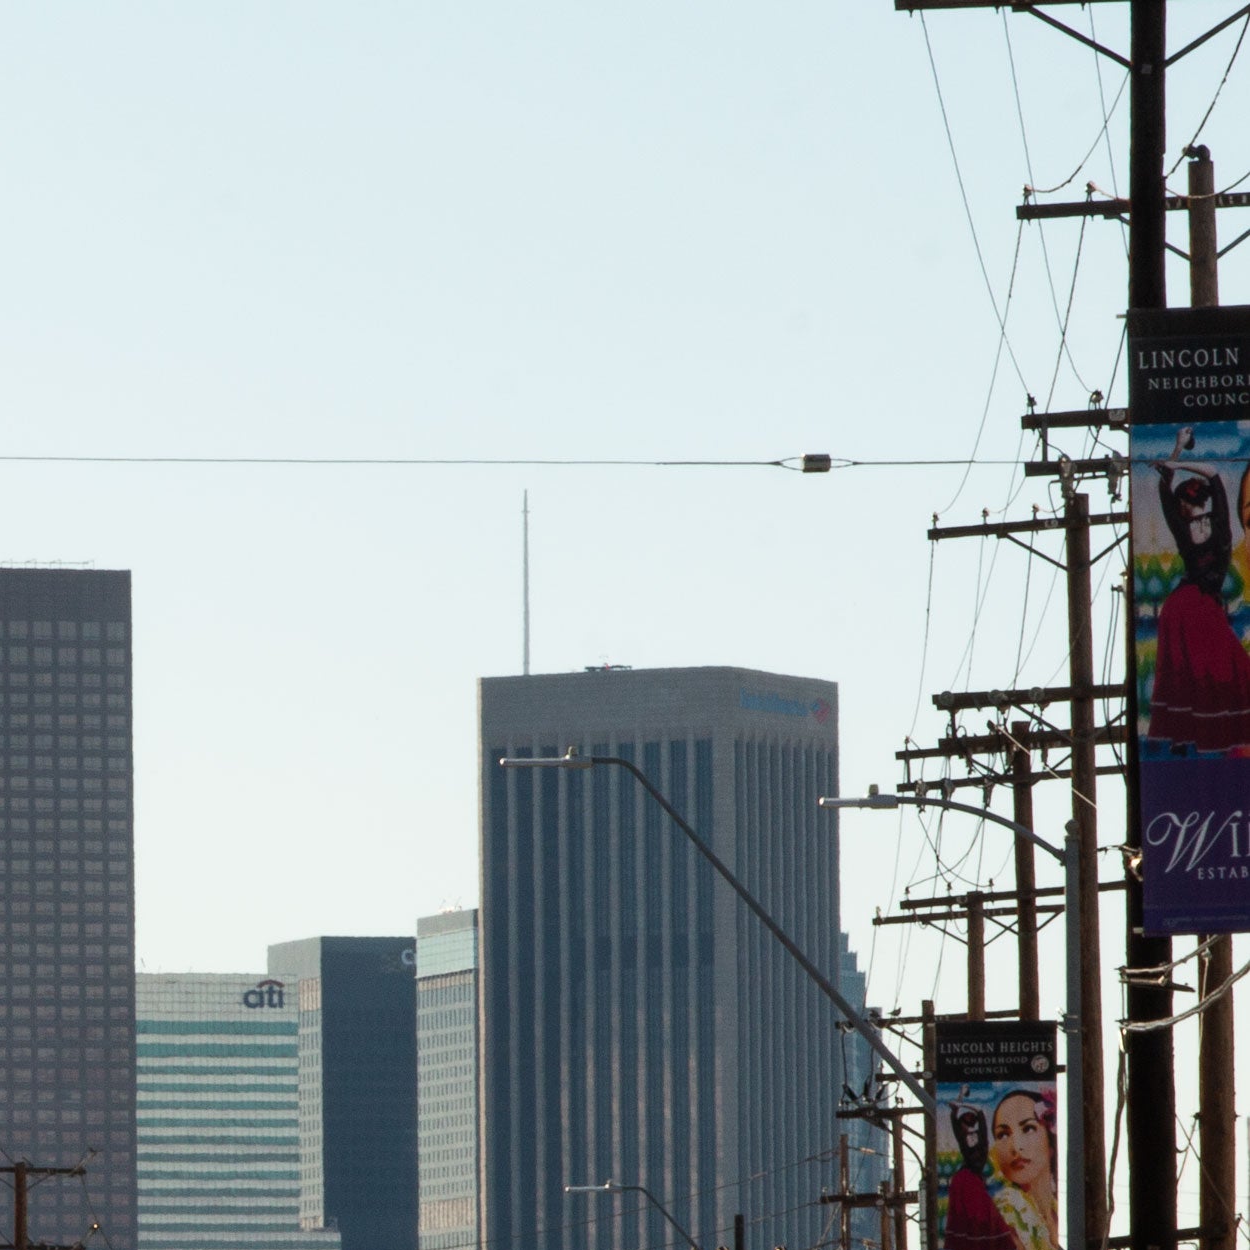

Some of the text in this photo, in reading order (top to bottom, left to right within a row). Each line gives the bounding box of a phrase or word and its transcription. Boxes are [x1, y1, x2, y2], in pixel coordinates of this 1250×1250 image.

[1138, 347, 1239, 370] LINCOLN
[1148, 374, 1250, 390] NEIGHBOR
[1197, 866, 1250, 880] ESTAB
[940, 1041, 1054, 1053] LINCOLN HEIGHTS
[945, 1056, 1029, 1065] NEIGHBORHOOD
[964, 1066, 1010, 1074] COUNCIL
